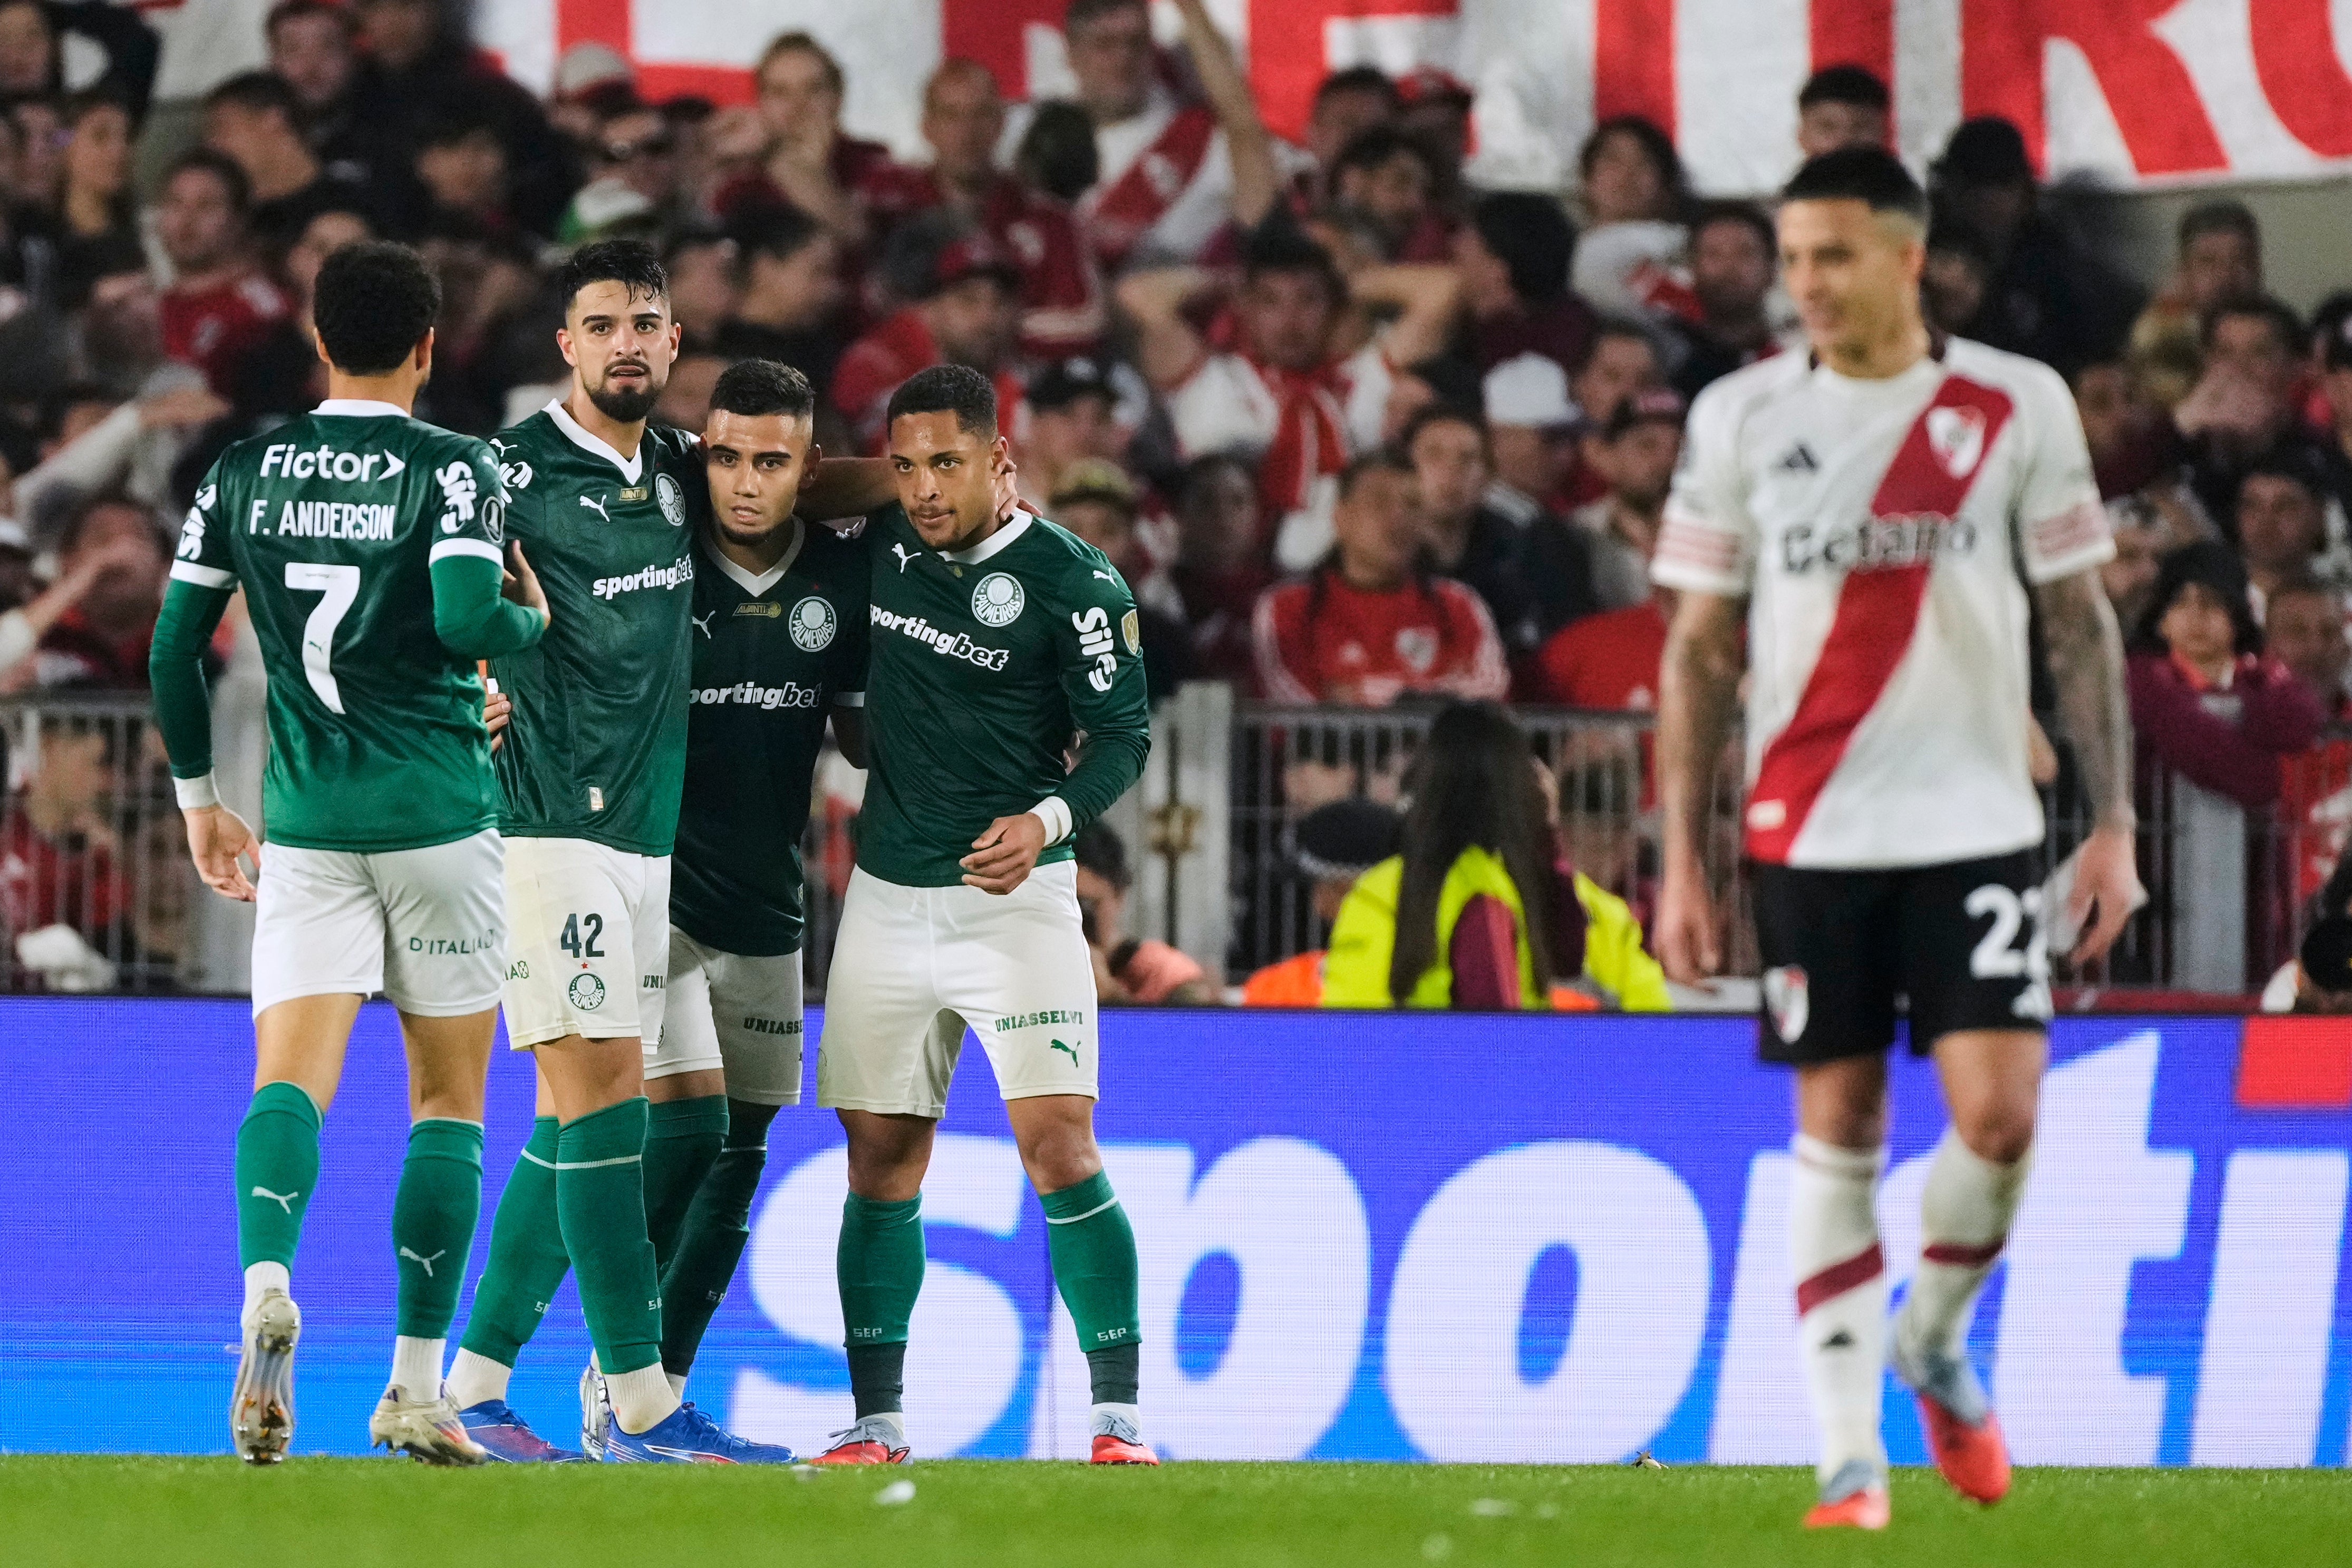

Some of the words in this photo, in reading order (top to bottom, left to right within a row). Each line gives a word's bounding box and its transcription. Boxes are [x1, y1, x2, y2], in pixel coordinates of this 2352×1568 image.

[260, 443, 380, 482] Fictor
[249, 499, 270, 536] F.
[278, 501, 395, 541] ANDERSON
[593, 553, 693, 600] sportingbet
[975, 594, 1021, 624] PALMEIRAS
[285, 562, 361, 714] 7
[792, 619, 834, 649] PALMEIRAS
[870, 604, 1010, 671] portingbet
[689, 682, 822, 710] portingbet
[560, 913, 605, 958] 42
[569, 989, 604, 1009] PALMEIRAS
[995, 1010, 1083, 1032] UNIASSELVI
[853, 1327, 882, 1338] SEP
[1097, 1327, 1127, 1342] SEP
